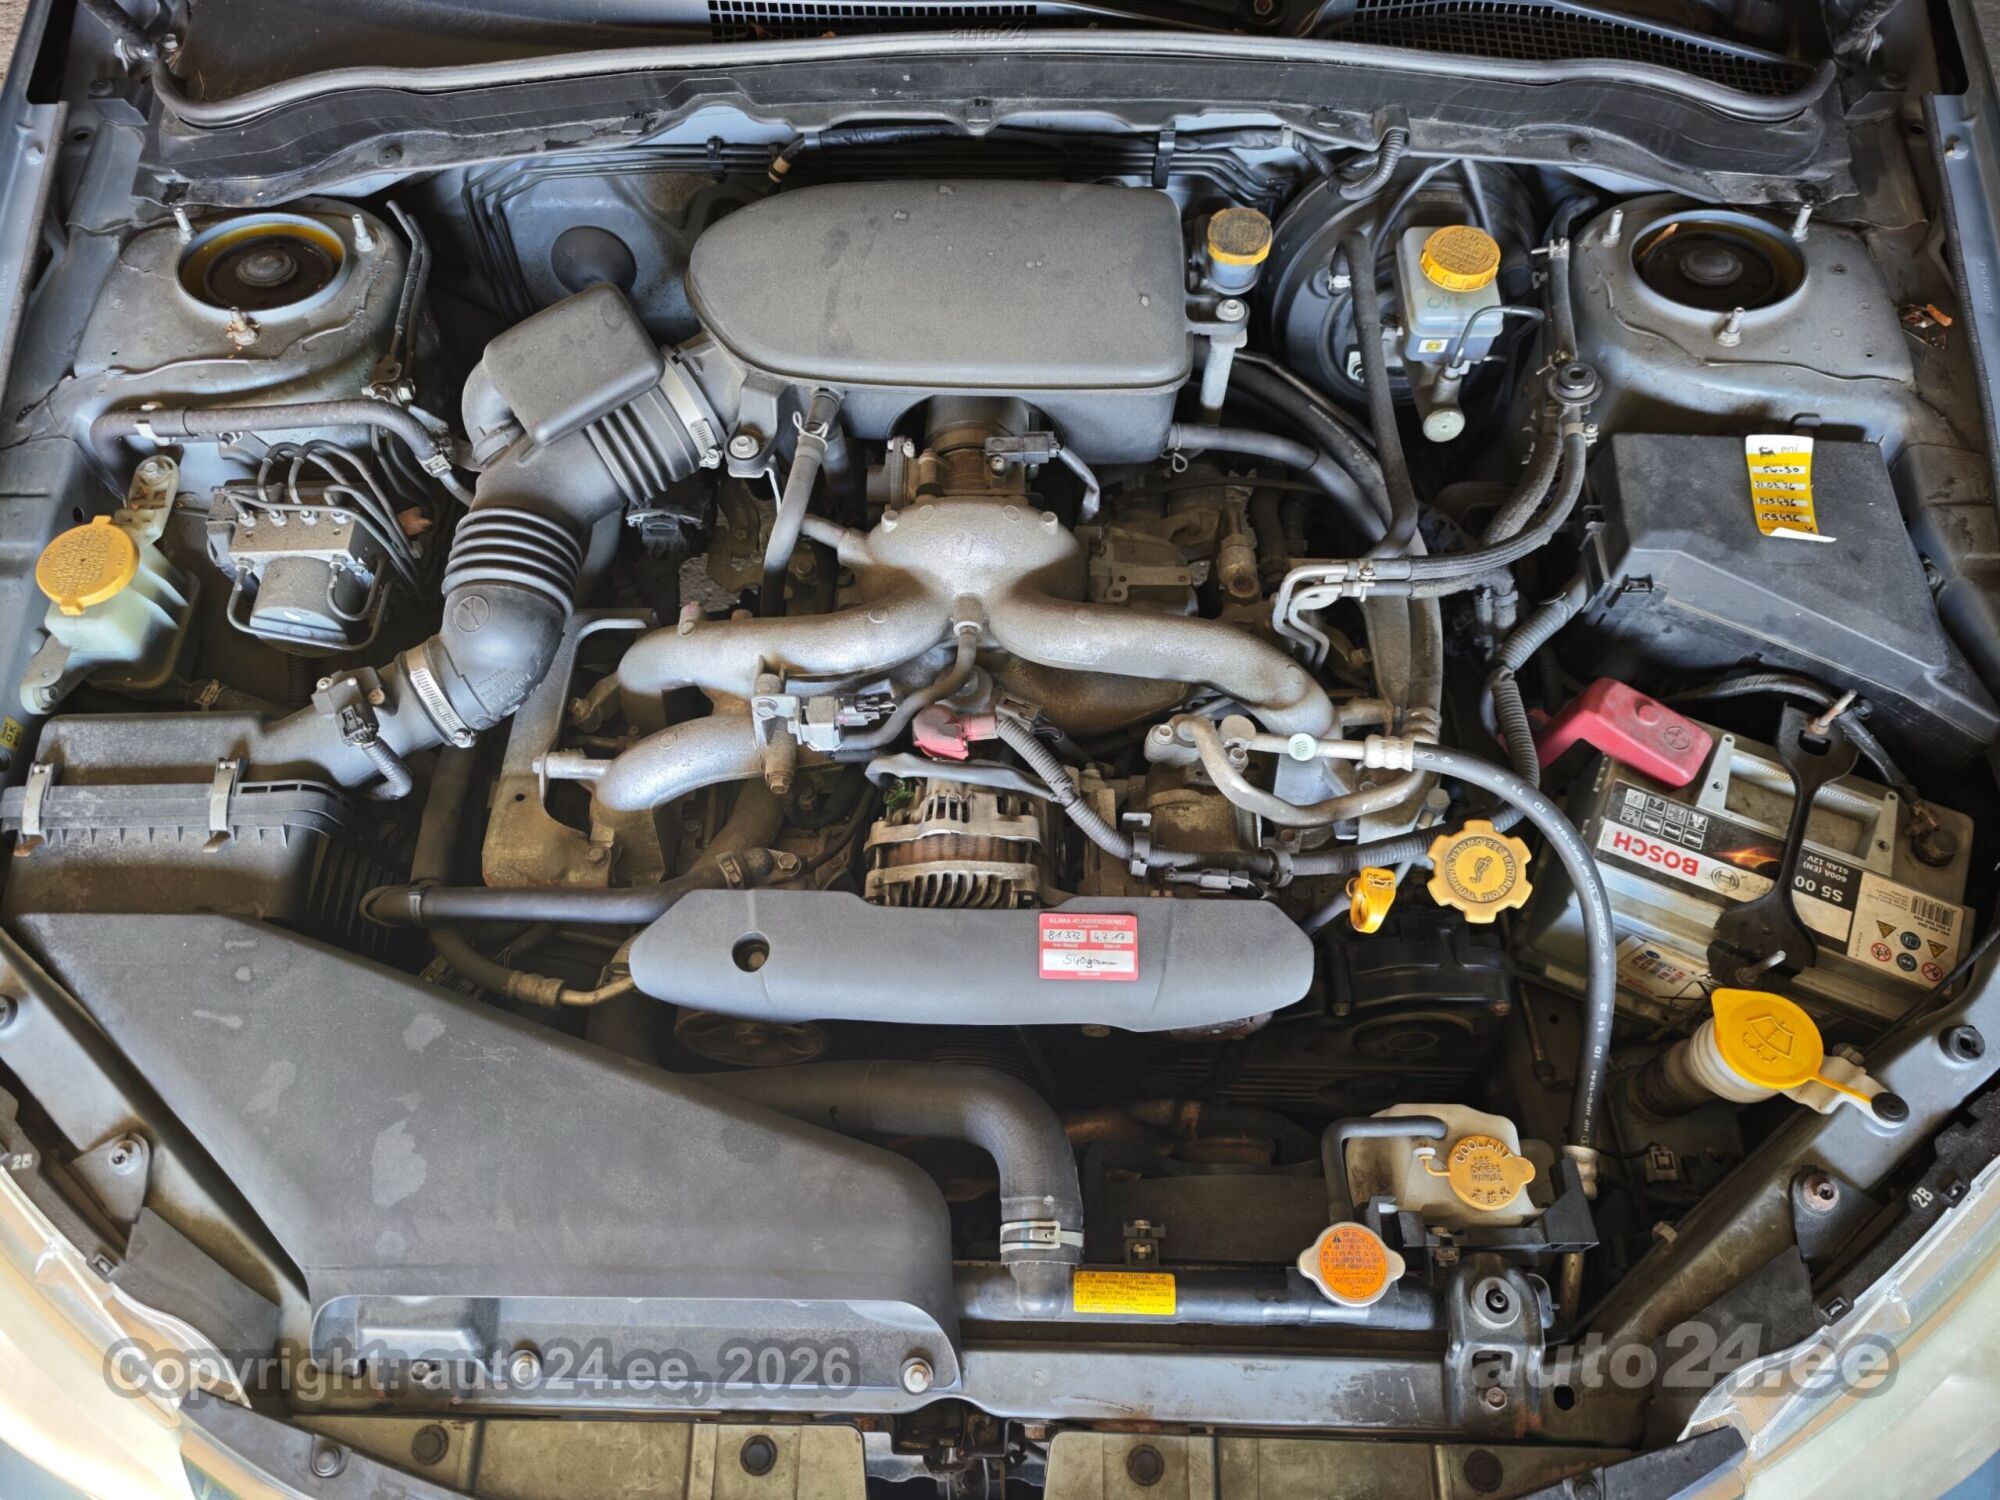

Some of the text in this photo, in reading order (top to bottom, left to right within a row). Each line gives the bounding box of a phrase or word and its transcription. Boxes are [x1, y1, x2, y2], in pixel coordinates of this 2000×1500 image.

[1612, 831, 1699, 877] BOSCH
[1820, 884, 1844, 903] S5
[1593, 1045, 1603, 1059] ID
[1455, 1139, 1514, 1163] COOLANT
[1912, 1187, 1934, 1208] 2B
